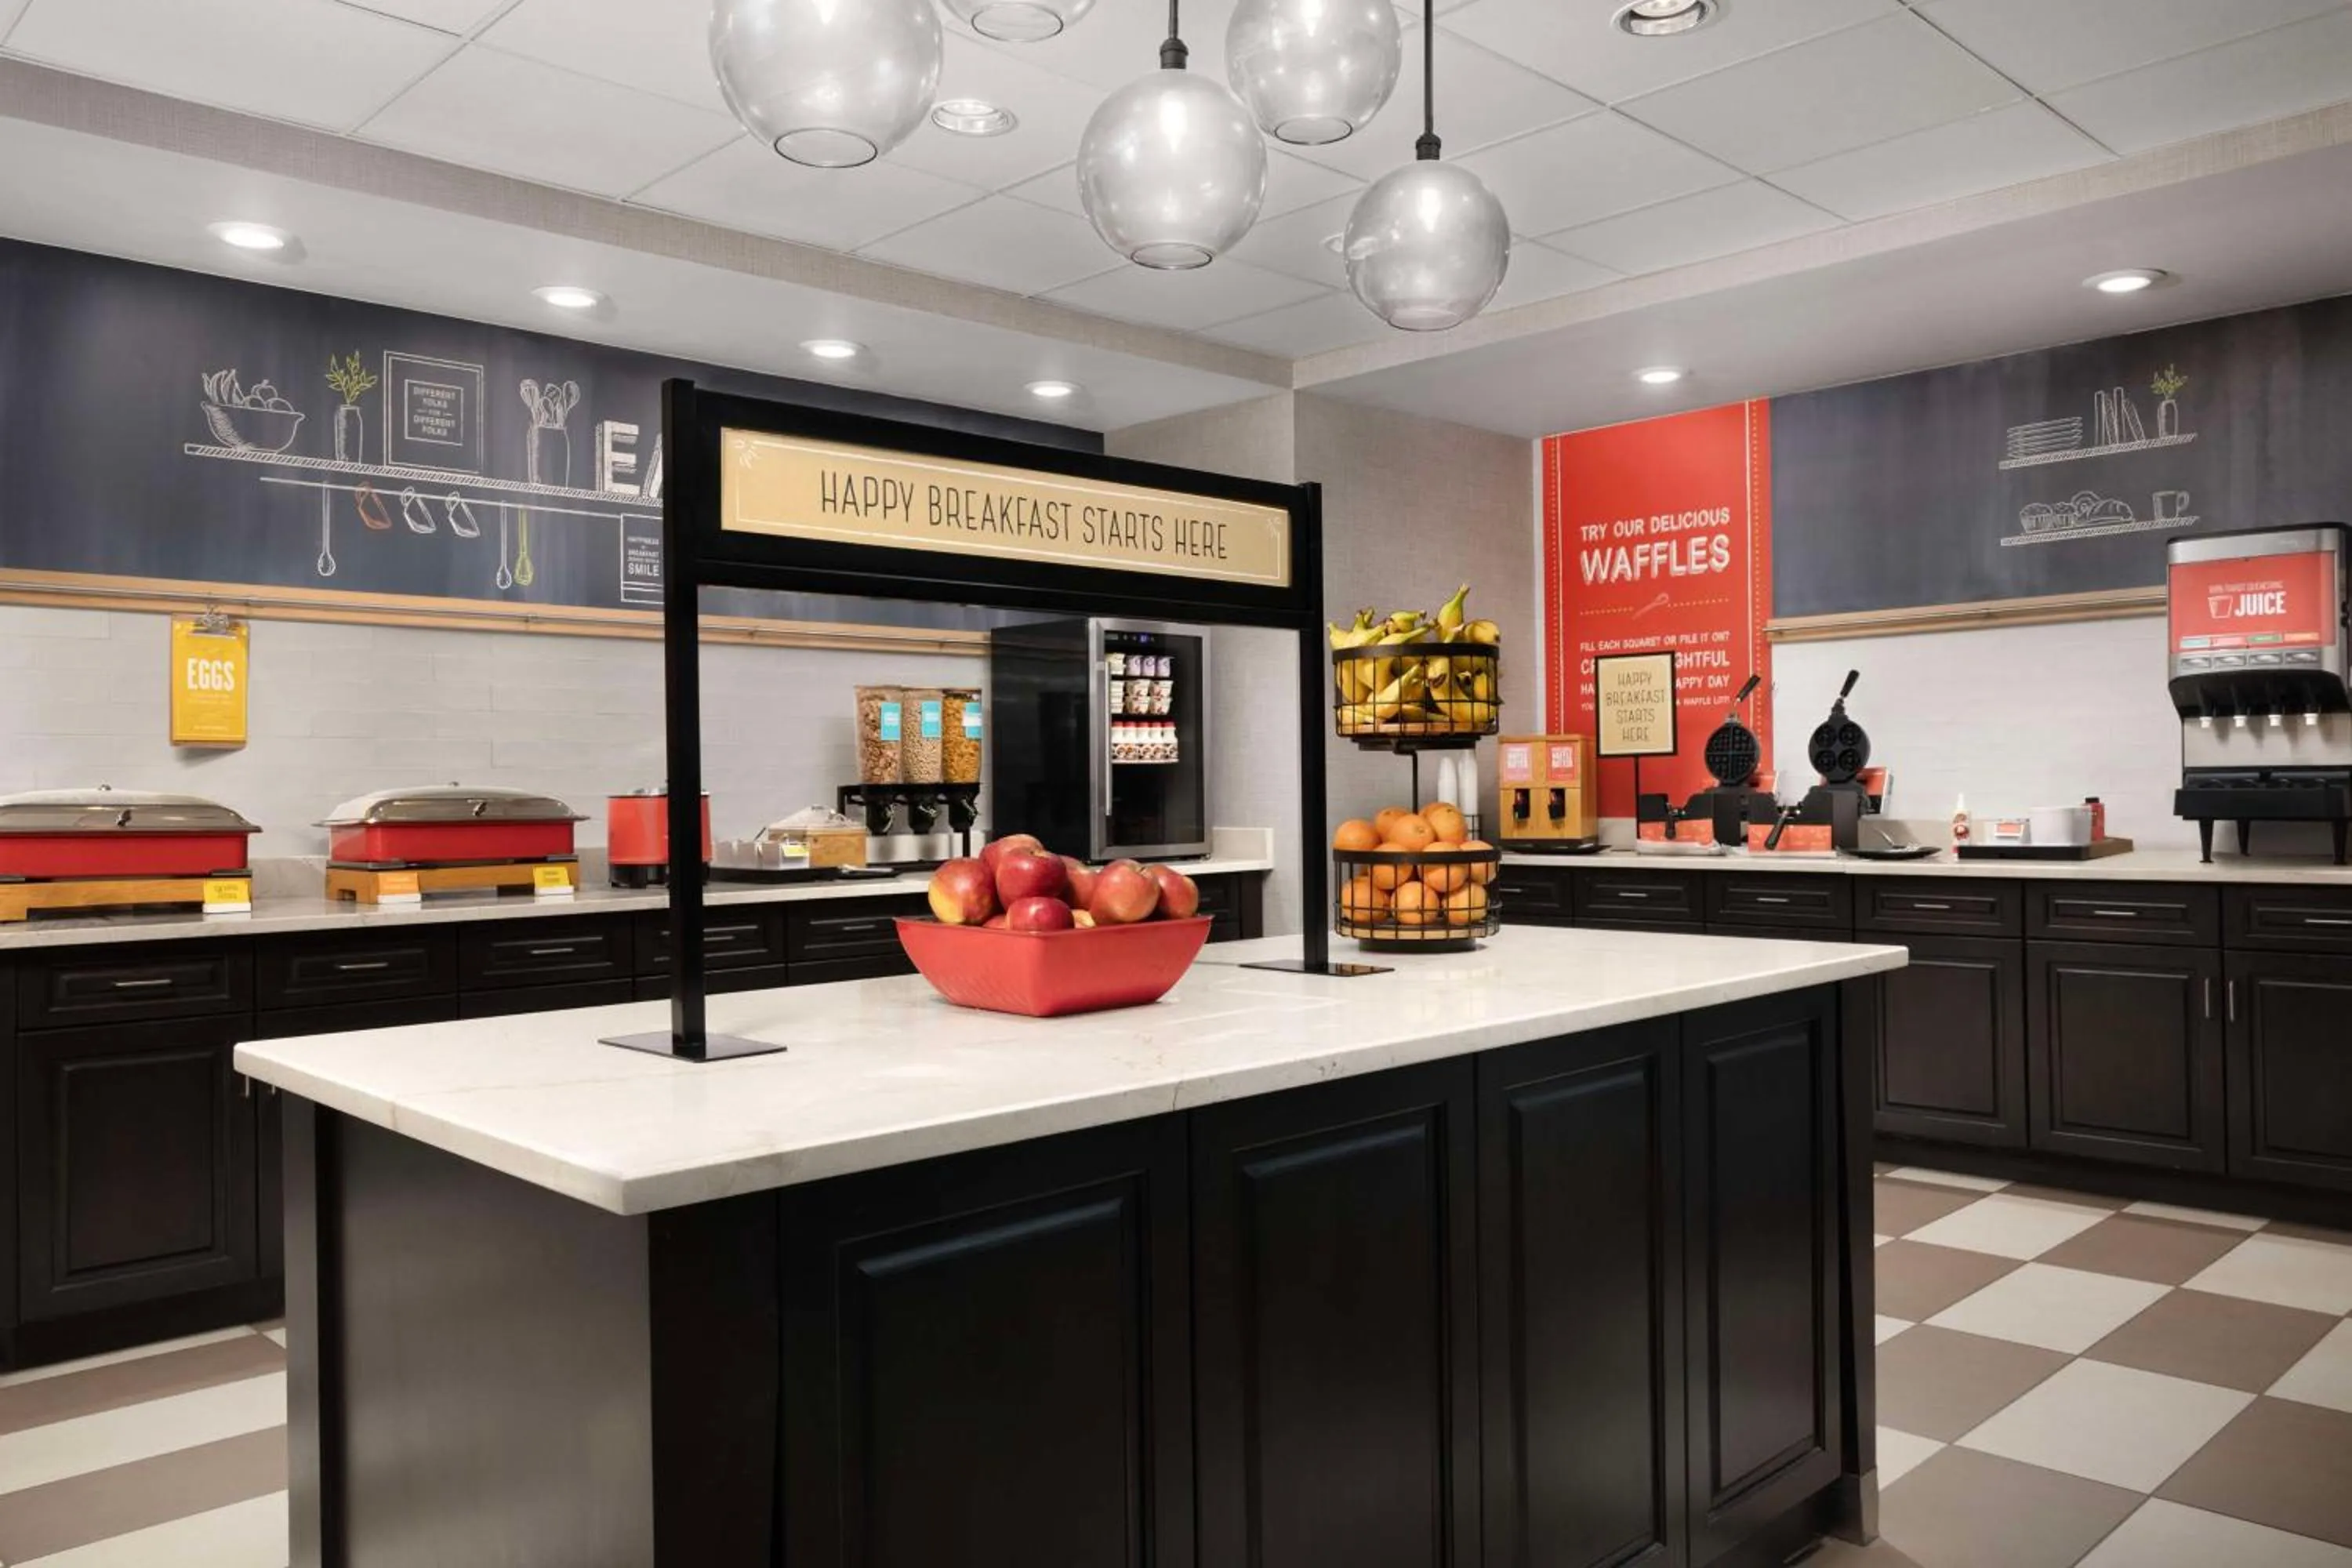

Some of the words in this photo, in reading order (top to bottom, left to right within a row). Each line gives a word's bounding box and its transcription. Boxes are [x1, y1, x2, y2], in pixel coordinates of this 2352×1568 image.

[821, 469, 914, 523] HAPPY
[928, 485, 1072, 542] BREAKFAST
[1083, 506, 1163, 552] STARTS
[1175, 517, 1229, 559] HERE
[1581, 523, 1608, 542] TRY
[1613, 518, 1644, 538] OUR
[1650, 507, 1730, 534] DELICIOUS
[1581, 534, 1730, 586] WAFFLES
[628, 563, 659, 577] SMILE
[2234, 590, 2287, 617] JUICE
[1580, 641, 1596, 652] FILL
[1599, 639, 1621, 651] EACH
[1664, 634, 1677, 646] OR
[1700, 632, 1709, 644] IT
[1675, 651, 1730, 669] GHTFUL
[187, 657, 235, 691] EGGS
[1617, 671, 1653, 687] HAPPY
[1675, 676, 1704, 690] APPY
[1708, 674, 1730, 688] DAY
[1606, 689, 1665, 706] BREAKFAST
[1616, 708, 1656, 724] STARTS
[1622, 726, 1651, 742] HERE
